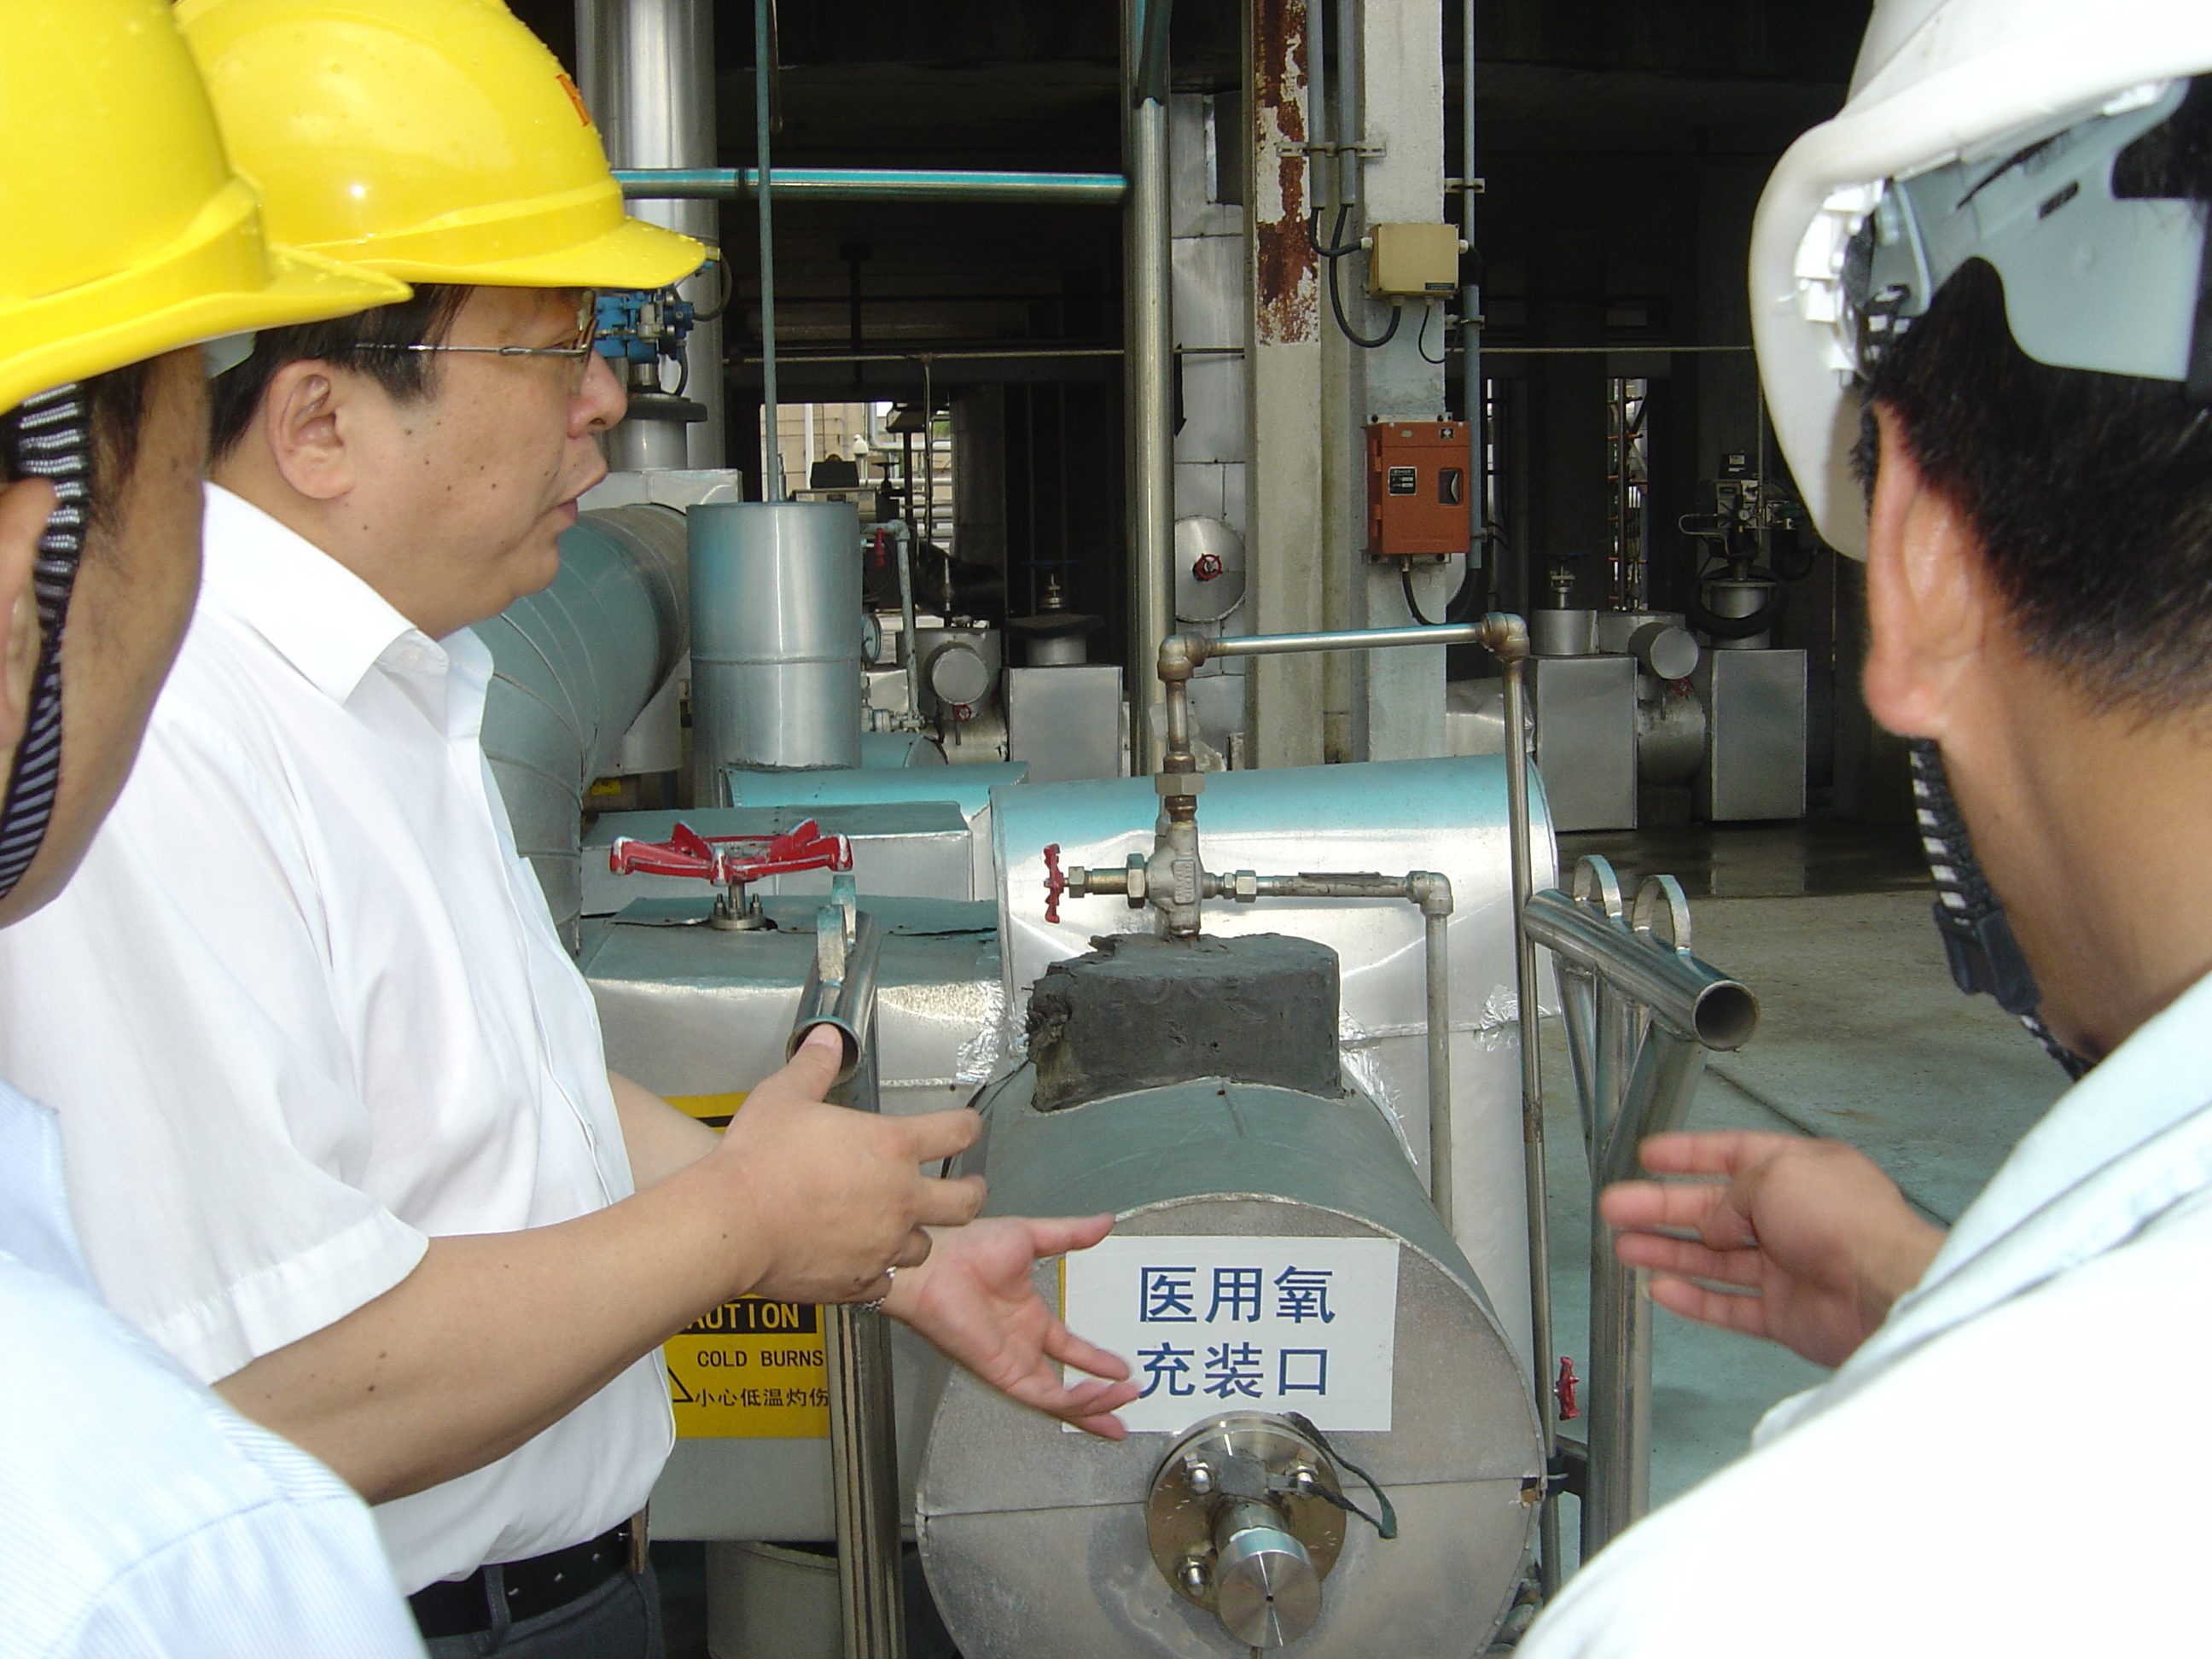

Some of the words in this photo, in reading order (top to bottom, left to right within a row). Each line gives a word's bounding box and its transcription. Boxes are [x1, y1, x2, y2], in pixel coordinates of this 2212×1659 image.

[1139, 1266, 1336, 1324] 医用氧
[696, 1350, 748, 1367] COLD
[760, 1349, 824, 1367] BURNS
[1137, 1341, 1328, 1400] 充装口
[695, 1388, 830, 1407] 小心低温灼伤
